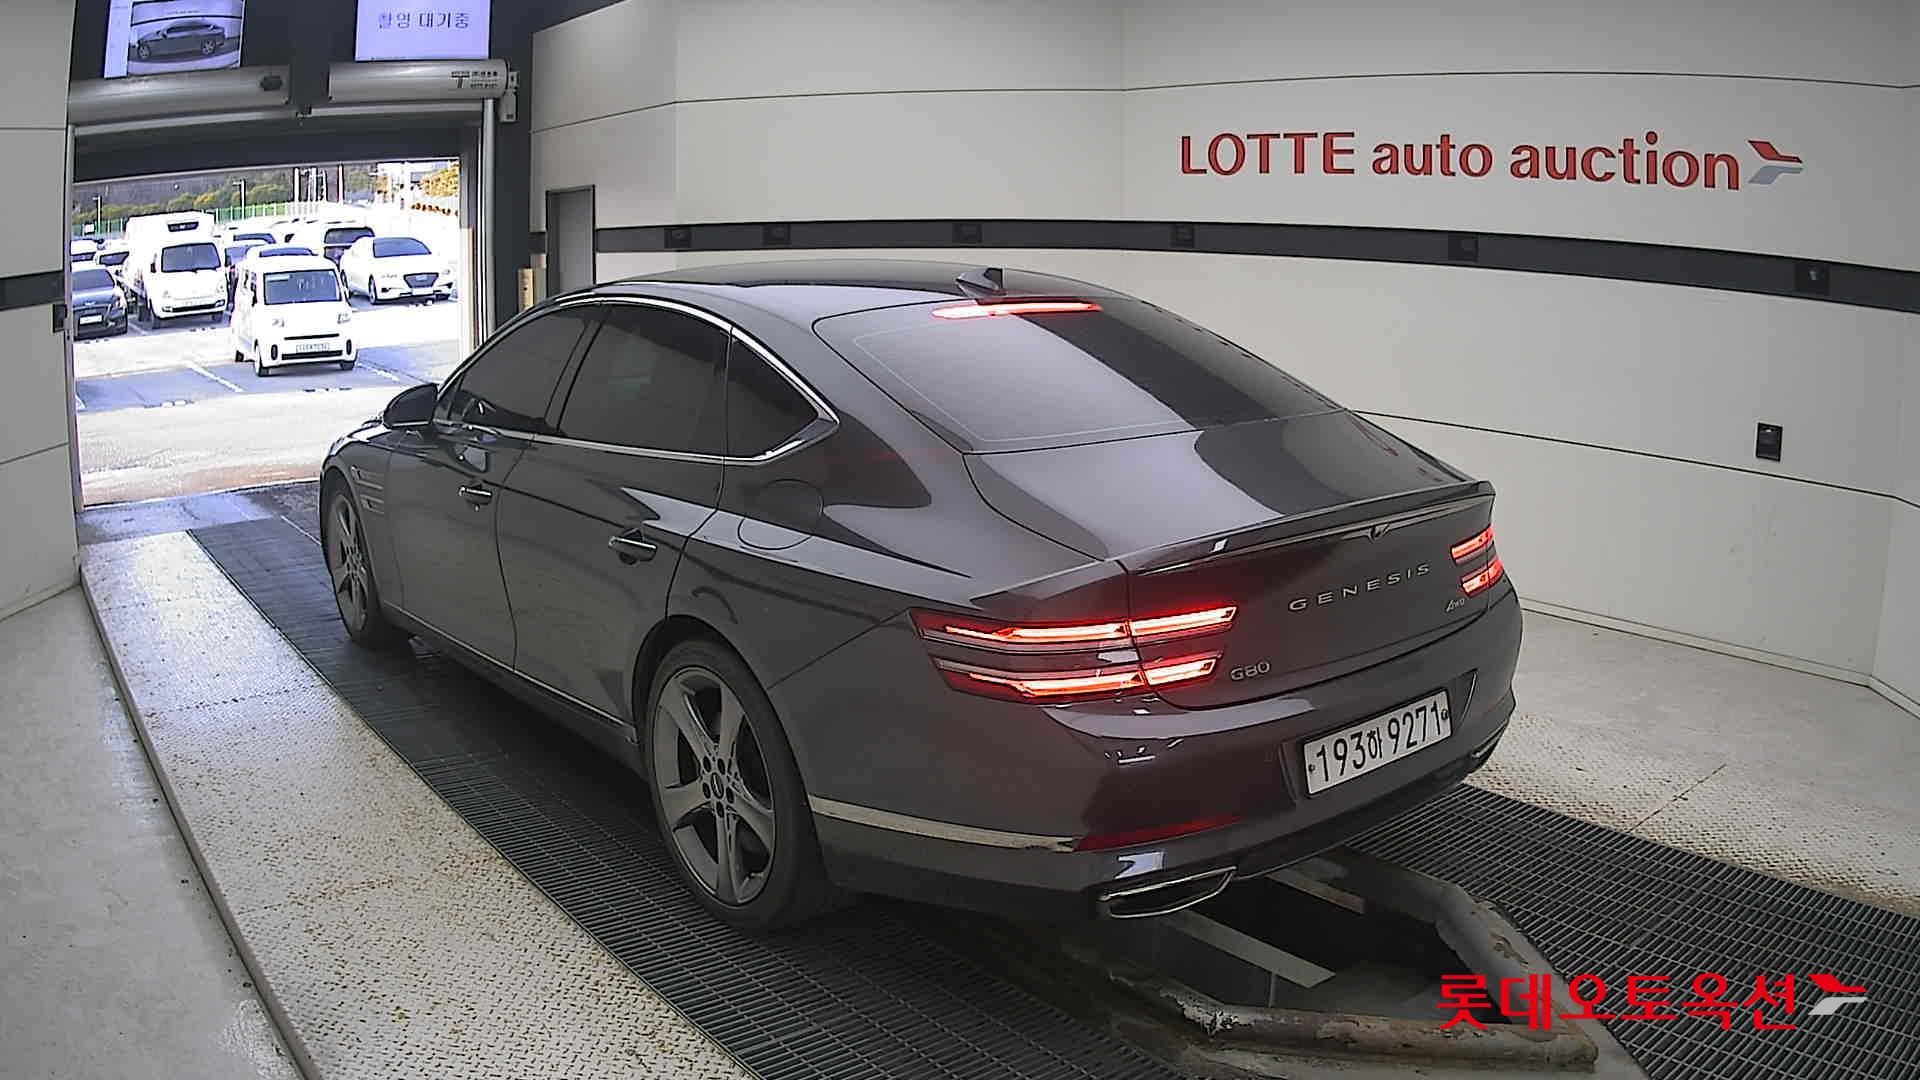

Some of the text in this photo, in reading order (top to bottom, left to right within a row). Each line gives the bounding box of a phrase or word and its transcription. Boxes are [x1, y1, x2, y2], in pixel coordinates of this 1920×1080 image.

[417, 12, 470, 29] 대기중
[1180, 131, 1741, 190] LOTTE auto auction
[1288, 562, 1431, 612] GENESIS
[1230, 661, 1271, 682] G80
[1316, 700, 1441, 782] 193하 9271
